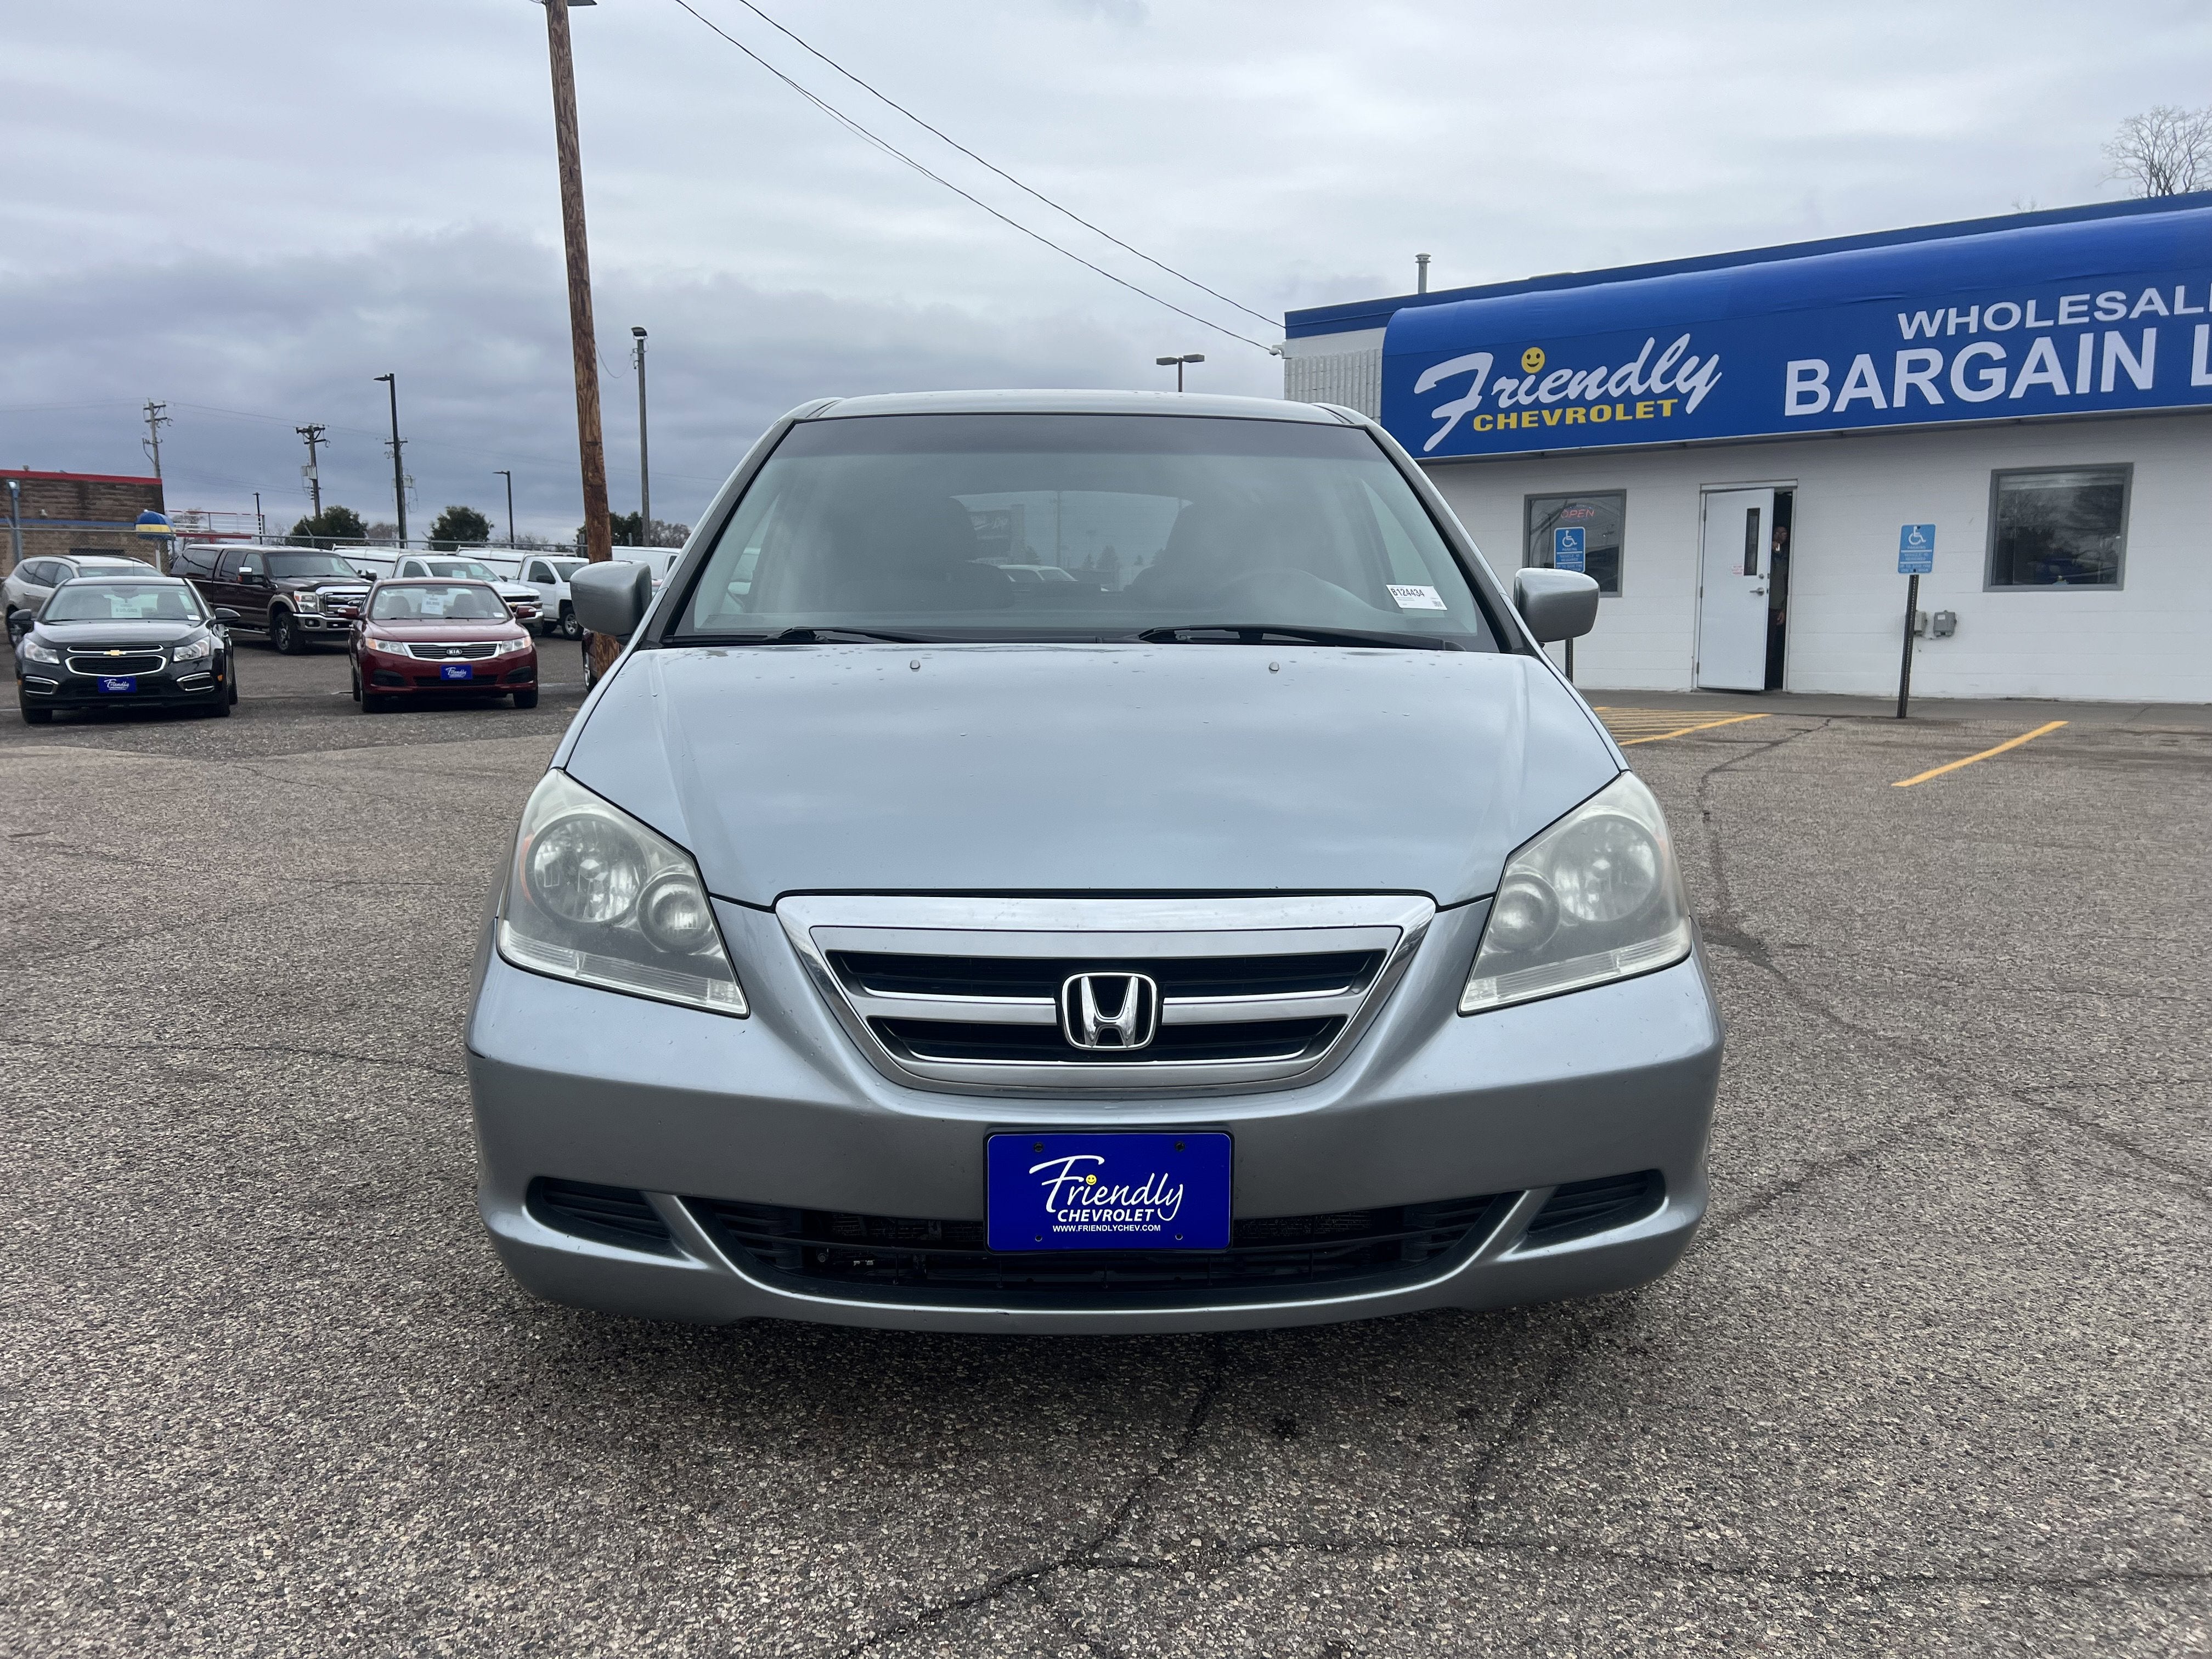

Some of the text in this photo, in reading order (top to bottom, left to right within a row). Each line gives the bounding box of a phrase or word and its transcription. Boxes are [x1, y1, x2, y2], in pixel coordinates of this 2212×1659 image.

[1898, 282, 2212, 340] WHOLESAL
[1784, 327, 2158, 416] BARGAIN
[1414, 332, 1723, 453] Friendly
[1473, 398, 1679, 432] CHEVROLET
[1560, 509, 1594, 518] OPEN
[1390, 588, 1425, 597] B124434
[104, 679, 129, 689] Friendly
[1029, 1155, 1184, 1221] Friendly
[1057, 1208, 1155, 1223] CHEVROLET
[1052, 1224, 1161, 1232] WWW.FRIENDLYCHEV.COM
